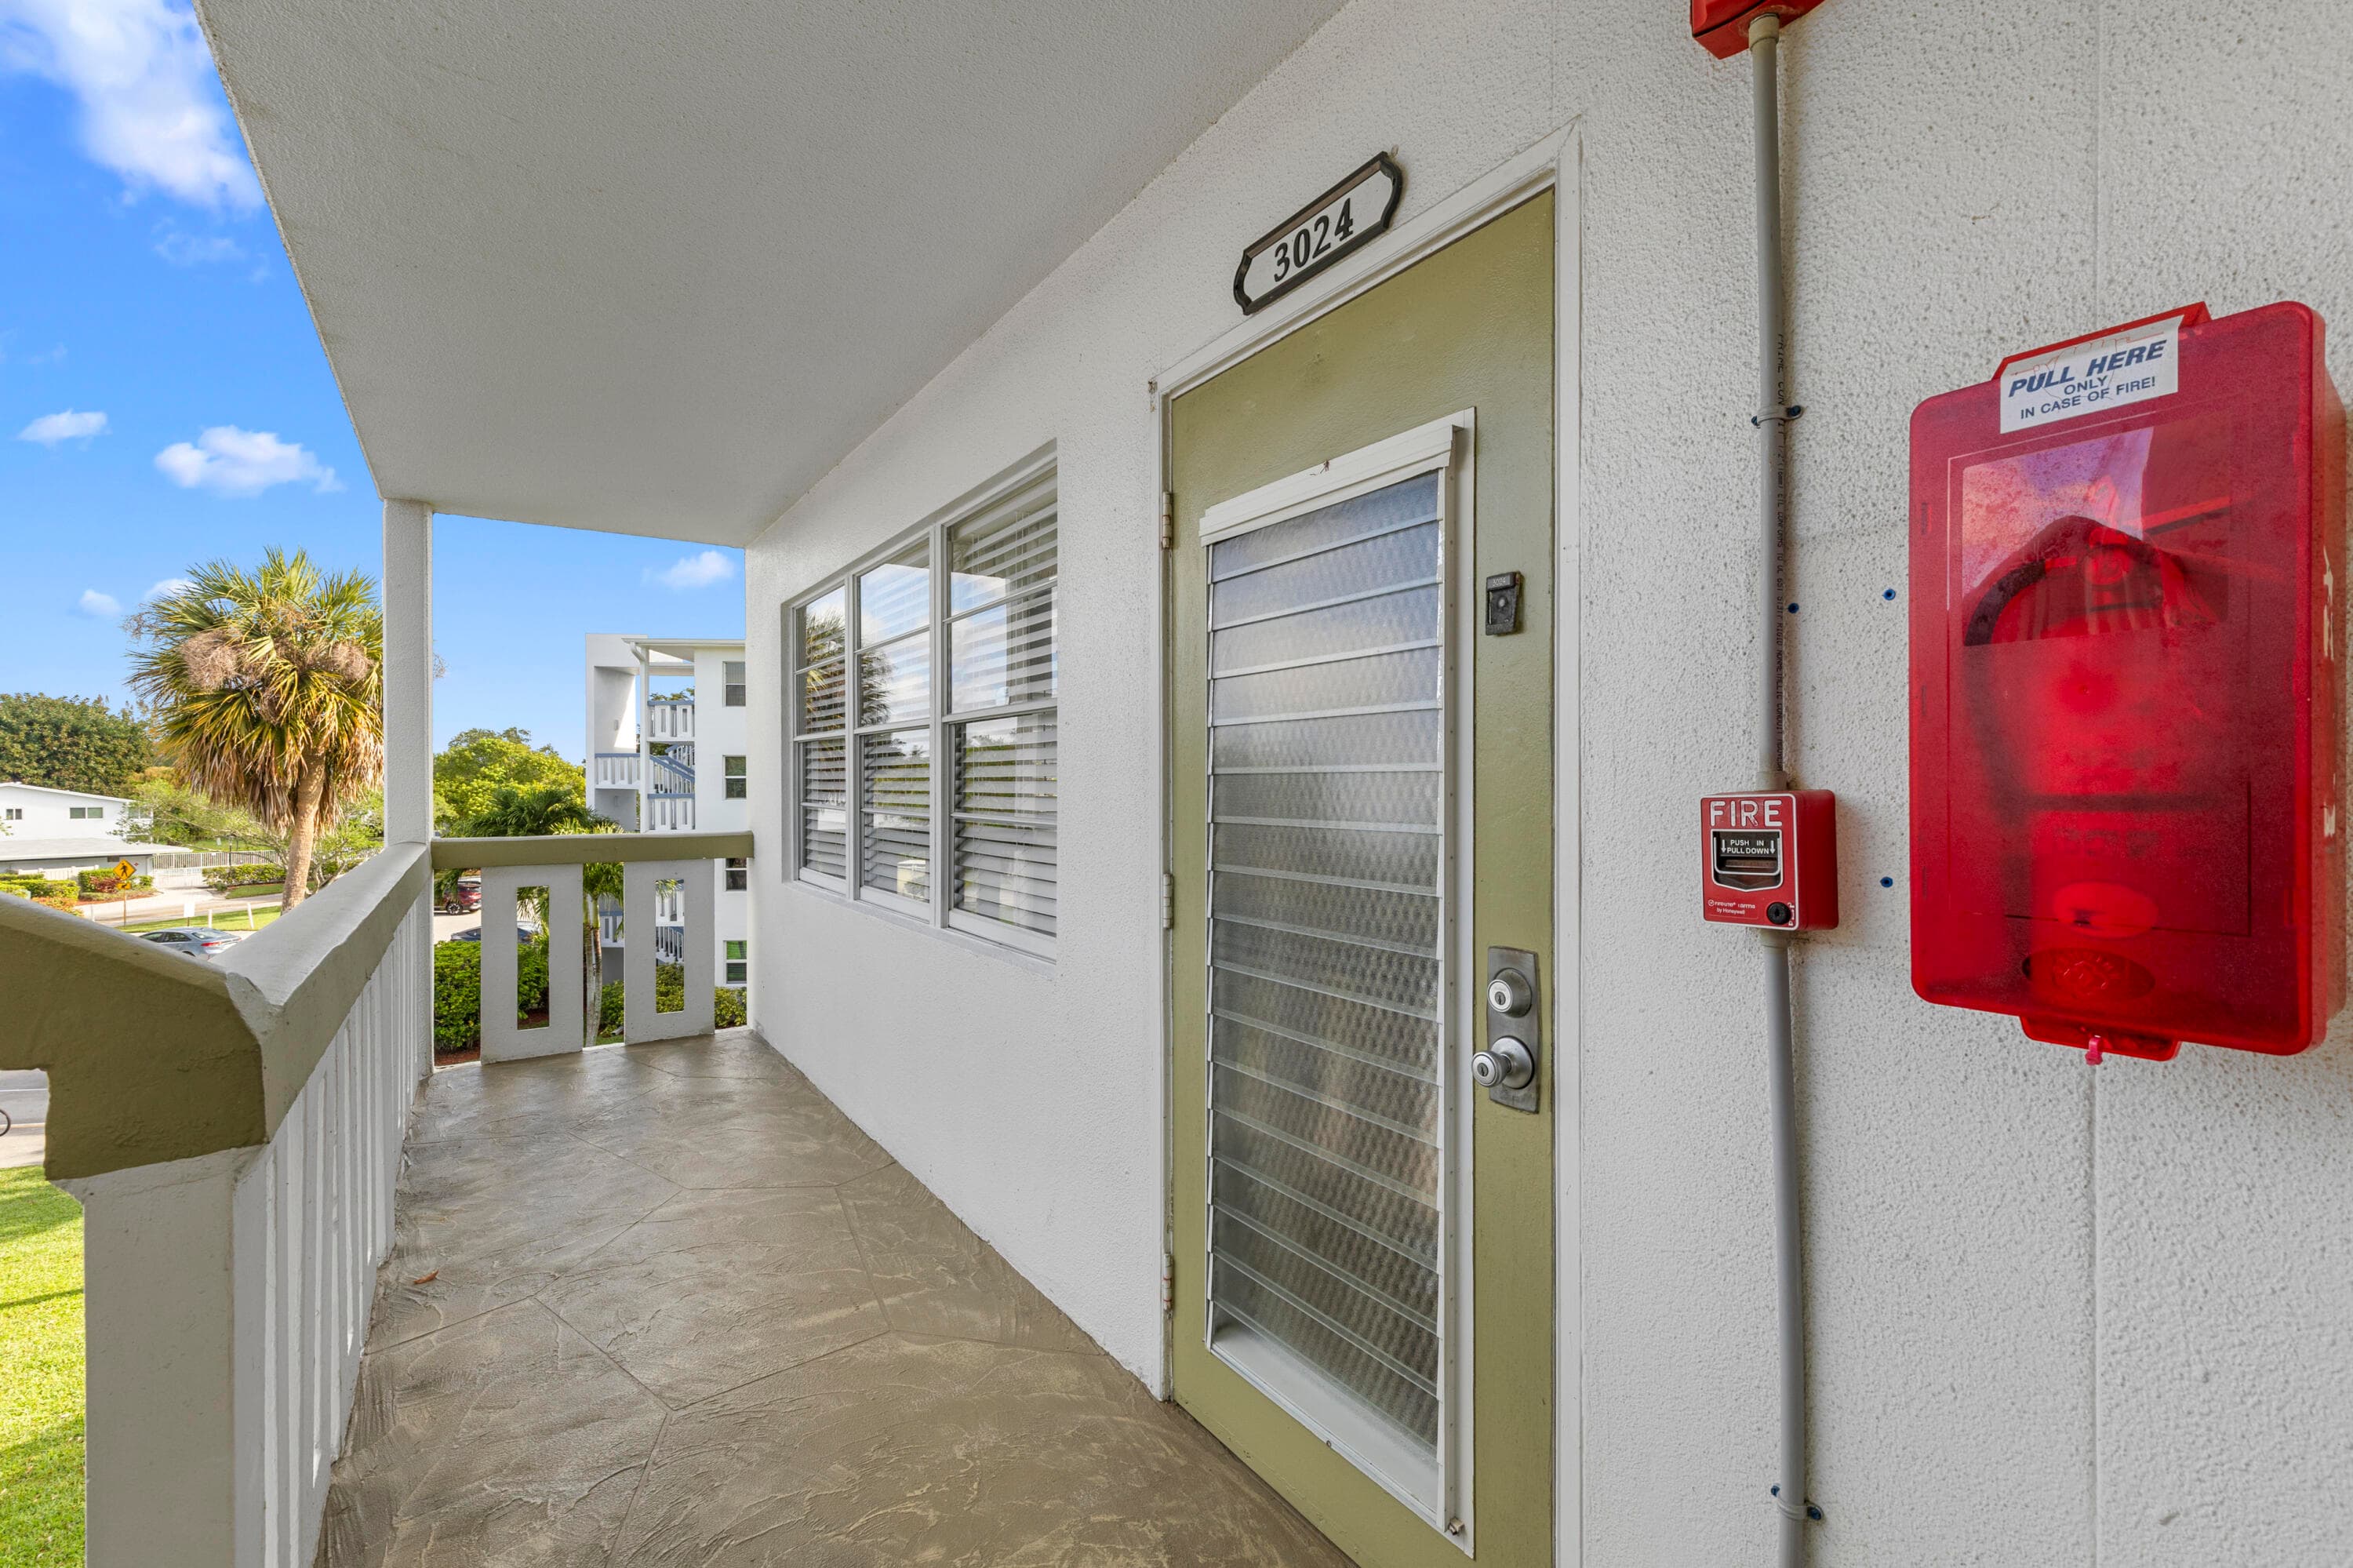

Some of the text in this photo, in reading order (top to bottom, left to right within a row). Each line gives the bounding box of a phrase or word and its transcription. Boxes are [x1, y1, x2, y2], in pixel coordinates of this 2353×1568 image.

[1273, 198, 1354, 282] 3024
[2009, 340, 2167, 398] PULL HERE
[2064, 375, 2108, 395] ONLY
[2020, 377, 2155, 419] IN CASE OF FIRE!
[1710, 800, 1783, 827] FIRE
